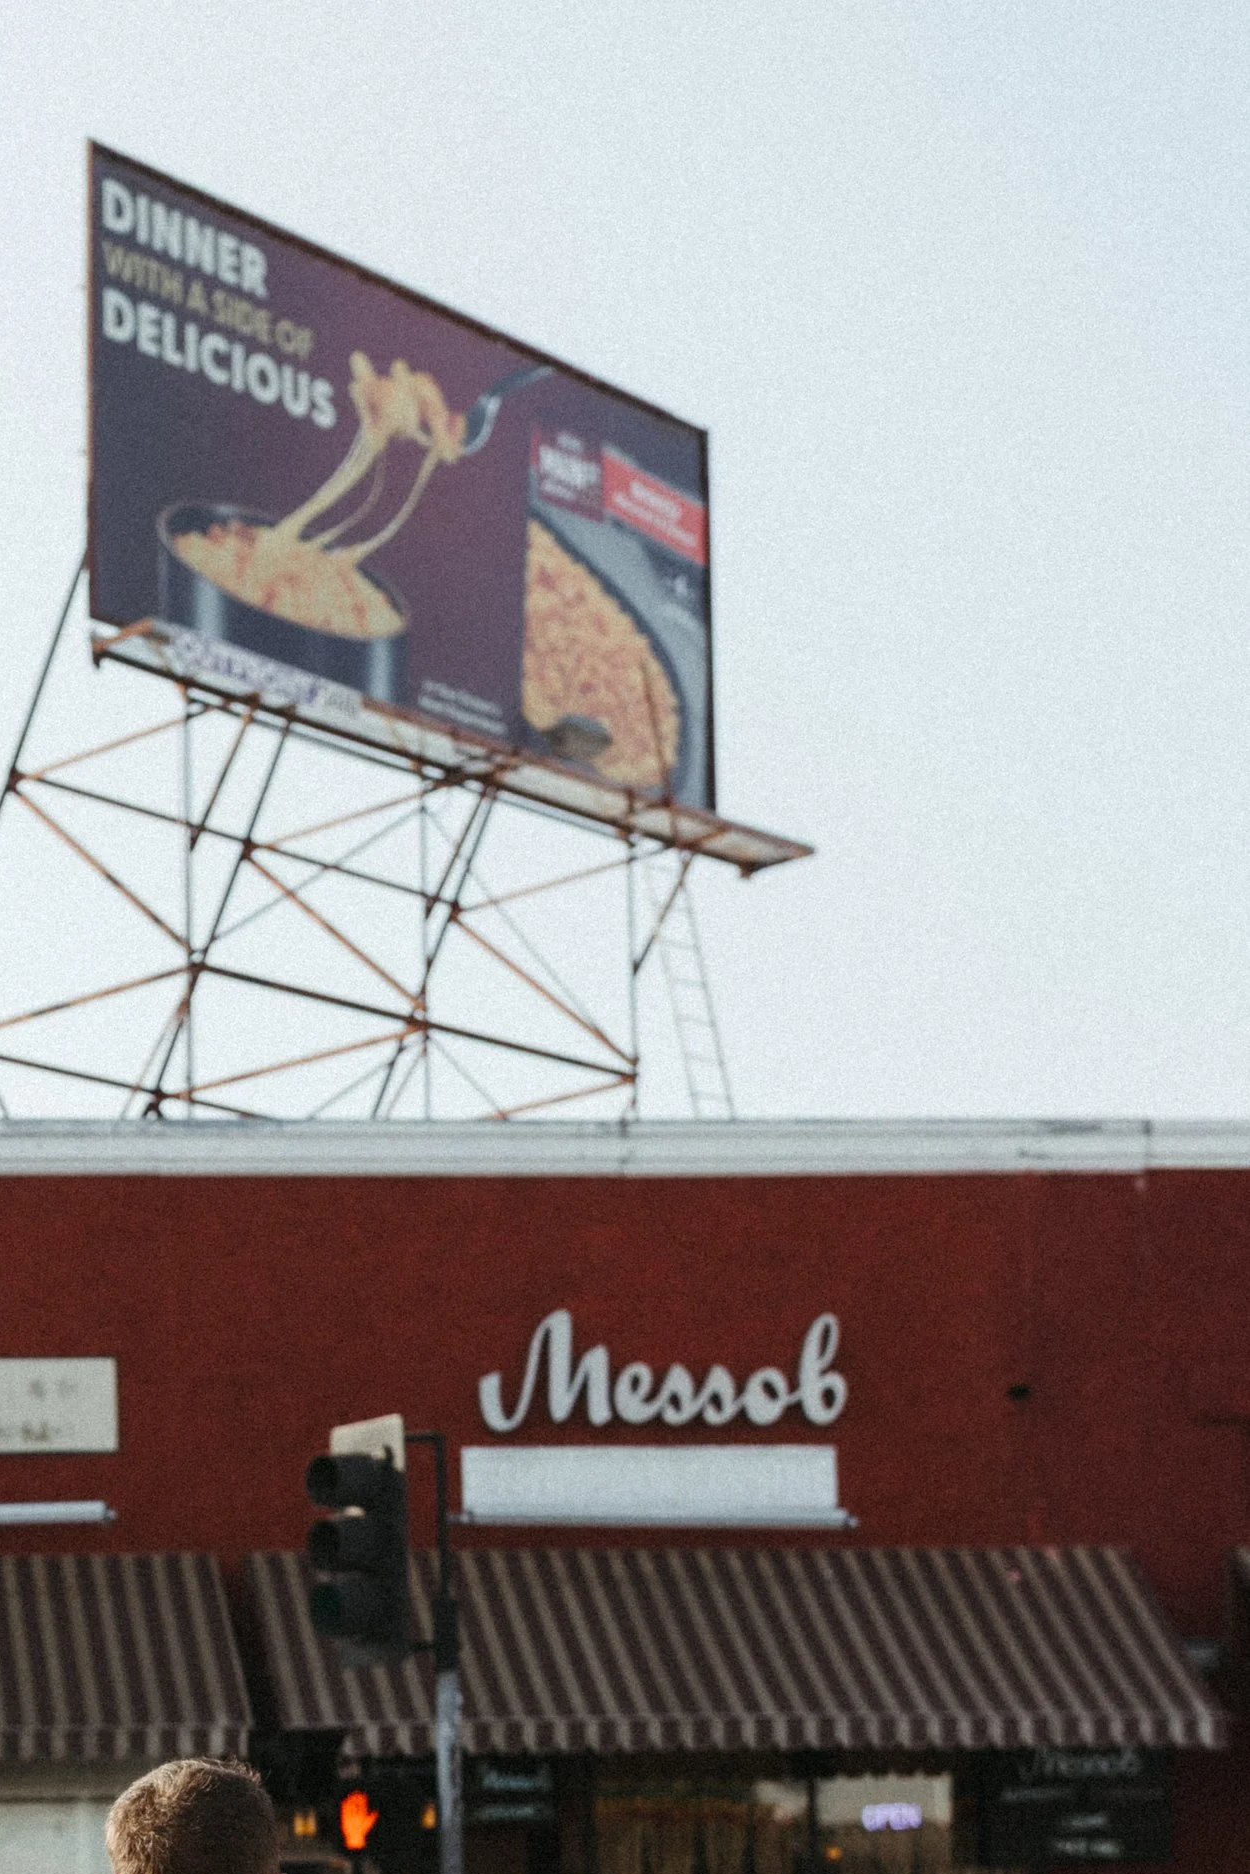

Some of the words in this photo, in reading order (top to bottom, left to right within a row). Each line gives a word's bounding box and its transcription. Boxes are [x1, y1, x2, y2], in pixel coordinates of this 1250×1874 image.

[101, 177, 268, 299] DINNER
[102, 239, 184, 305] WITH
[186, 279, 208, 318] A
[210, 289, 273, 346] SIDE
[274, 319, 315, 361] OF
[101, 286, 338, 430] DELICIOUS
[477, 1307, 848, 1434] Messob
